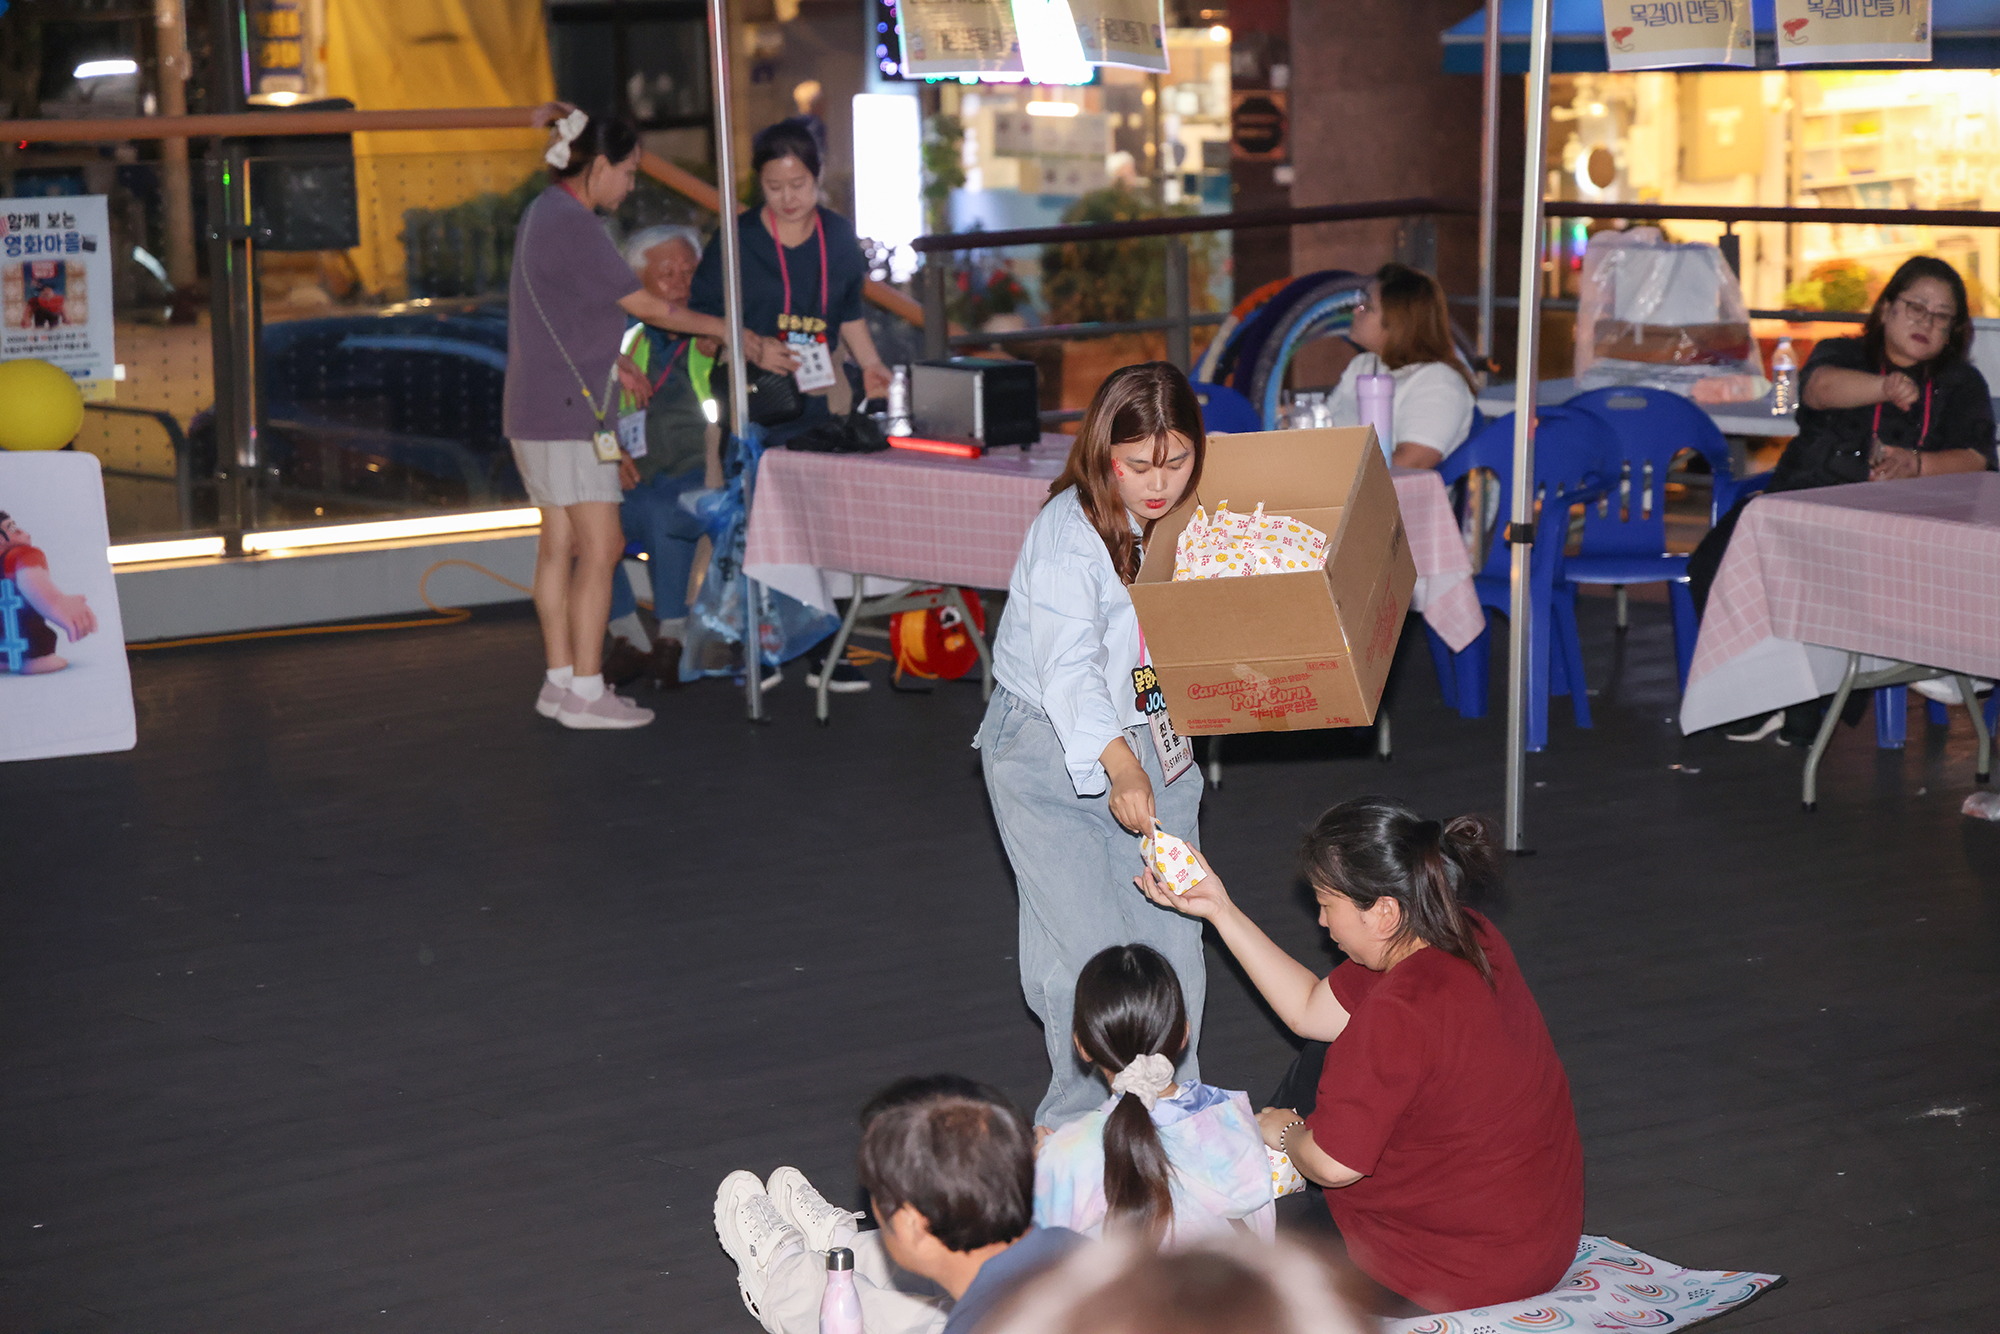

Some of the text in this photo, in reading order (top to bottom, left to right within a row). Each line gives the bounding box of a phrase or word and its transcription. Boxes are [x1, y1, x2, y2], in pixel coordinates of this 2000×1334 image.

[1630, 0, 1734, 27] 목걸이 만들기
[1807, 0, 1858, 19] 목걸이
[8, 210, 76, 232] 함께 보는
[1187, 673, 1259, 700] Caramel
[1264, 685, 1312, 705] Corn
[1249, 698, 1319, 721] 카라멜맛팝콘
[1169, 751, 1183, 768] STAFF
